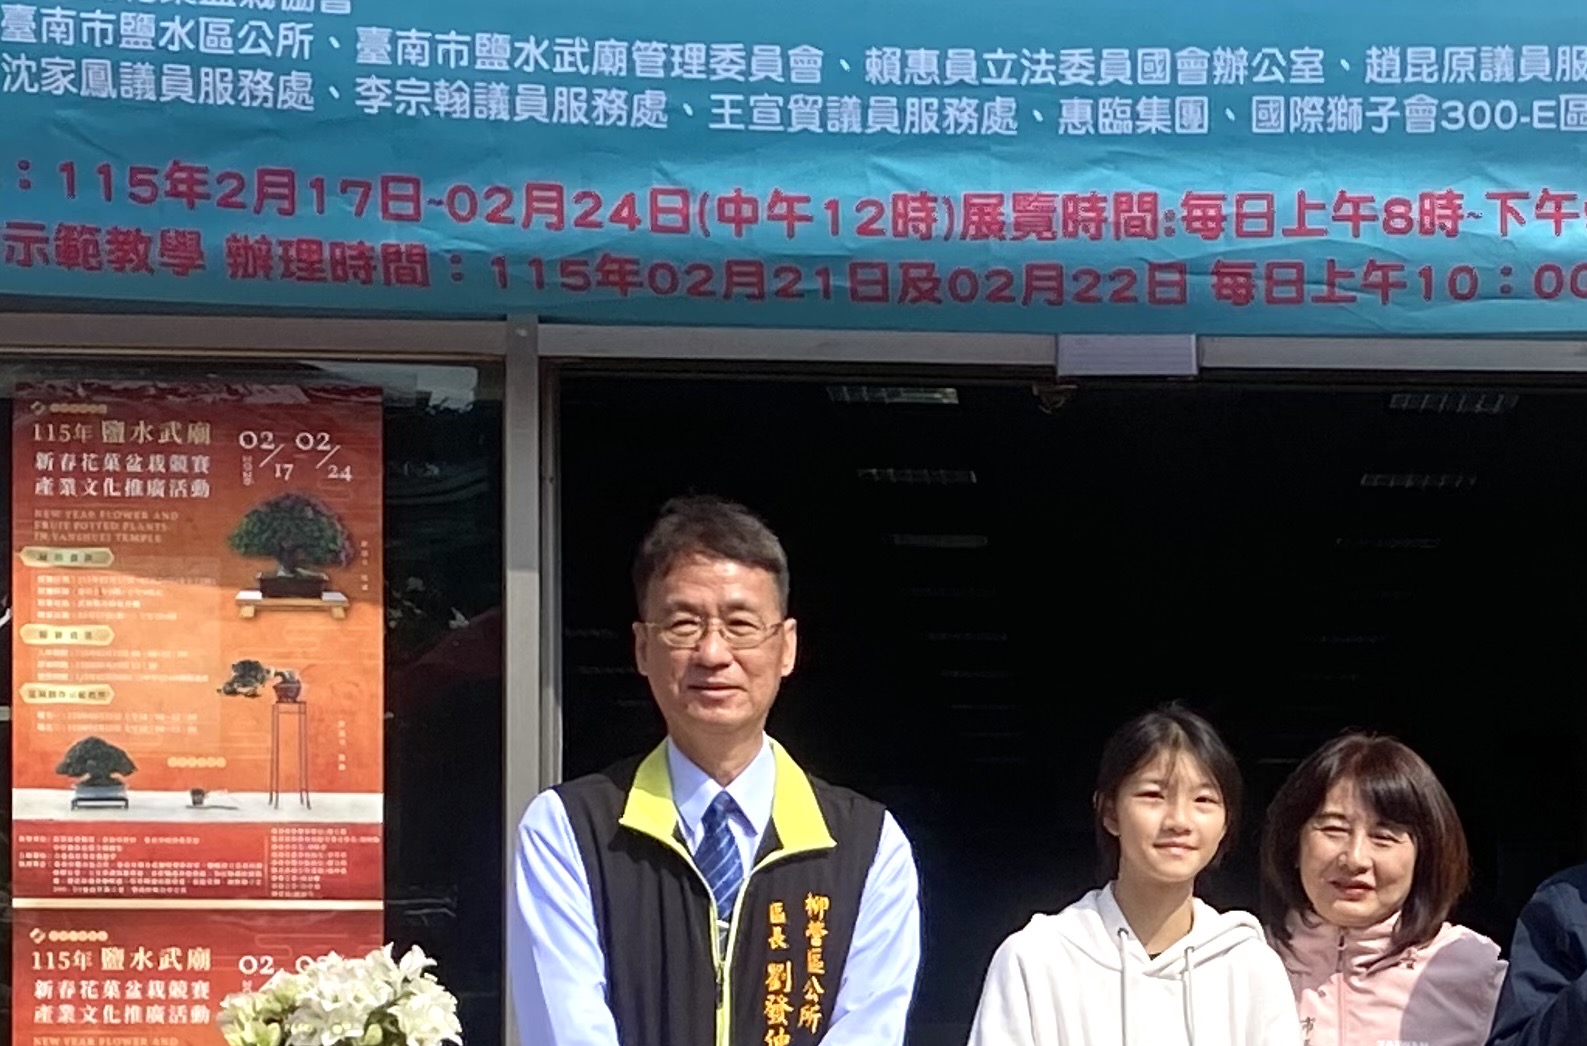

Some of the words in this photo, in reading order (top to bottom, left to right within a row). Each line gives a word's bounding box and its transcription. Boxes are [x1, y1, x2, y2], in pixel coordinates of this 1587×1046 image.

[3, 222, 206, 278] 示範教學
[33, 423, 94, 443] 115年
[101, 419, 212, 445] 鹽水武廟
[34, 452, 210, 475] 新春花菓盆栽競賽
[34, 477, 210, 499] 產業文化推廣活動
[768, 902, 790, 949] 區長
[32, 951, 94, 971] 115年
[101, 946, 212, 972] 鹽水武廟
[796, 892, 830, 1034] 柳營區公所
[34, 979, 210, 1001] 新春花菓盆栽競賽
[33, 1004, 211, 1025] 產業文化推廣活動
